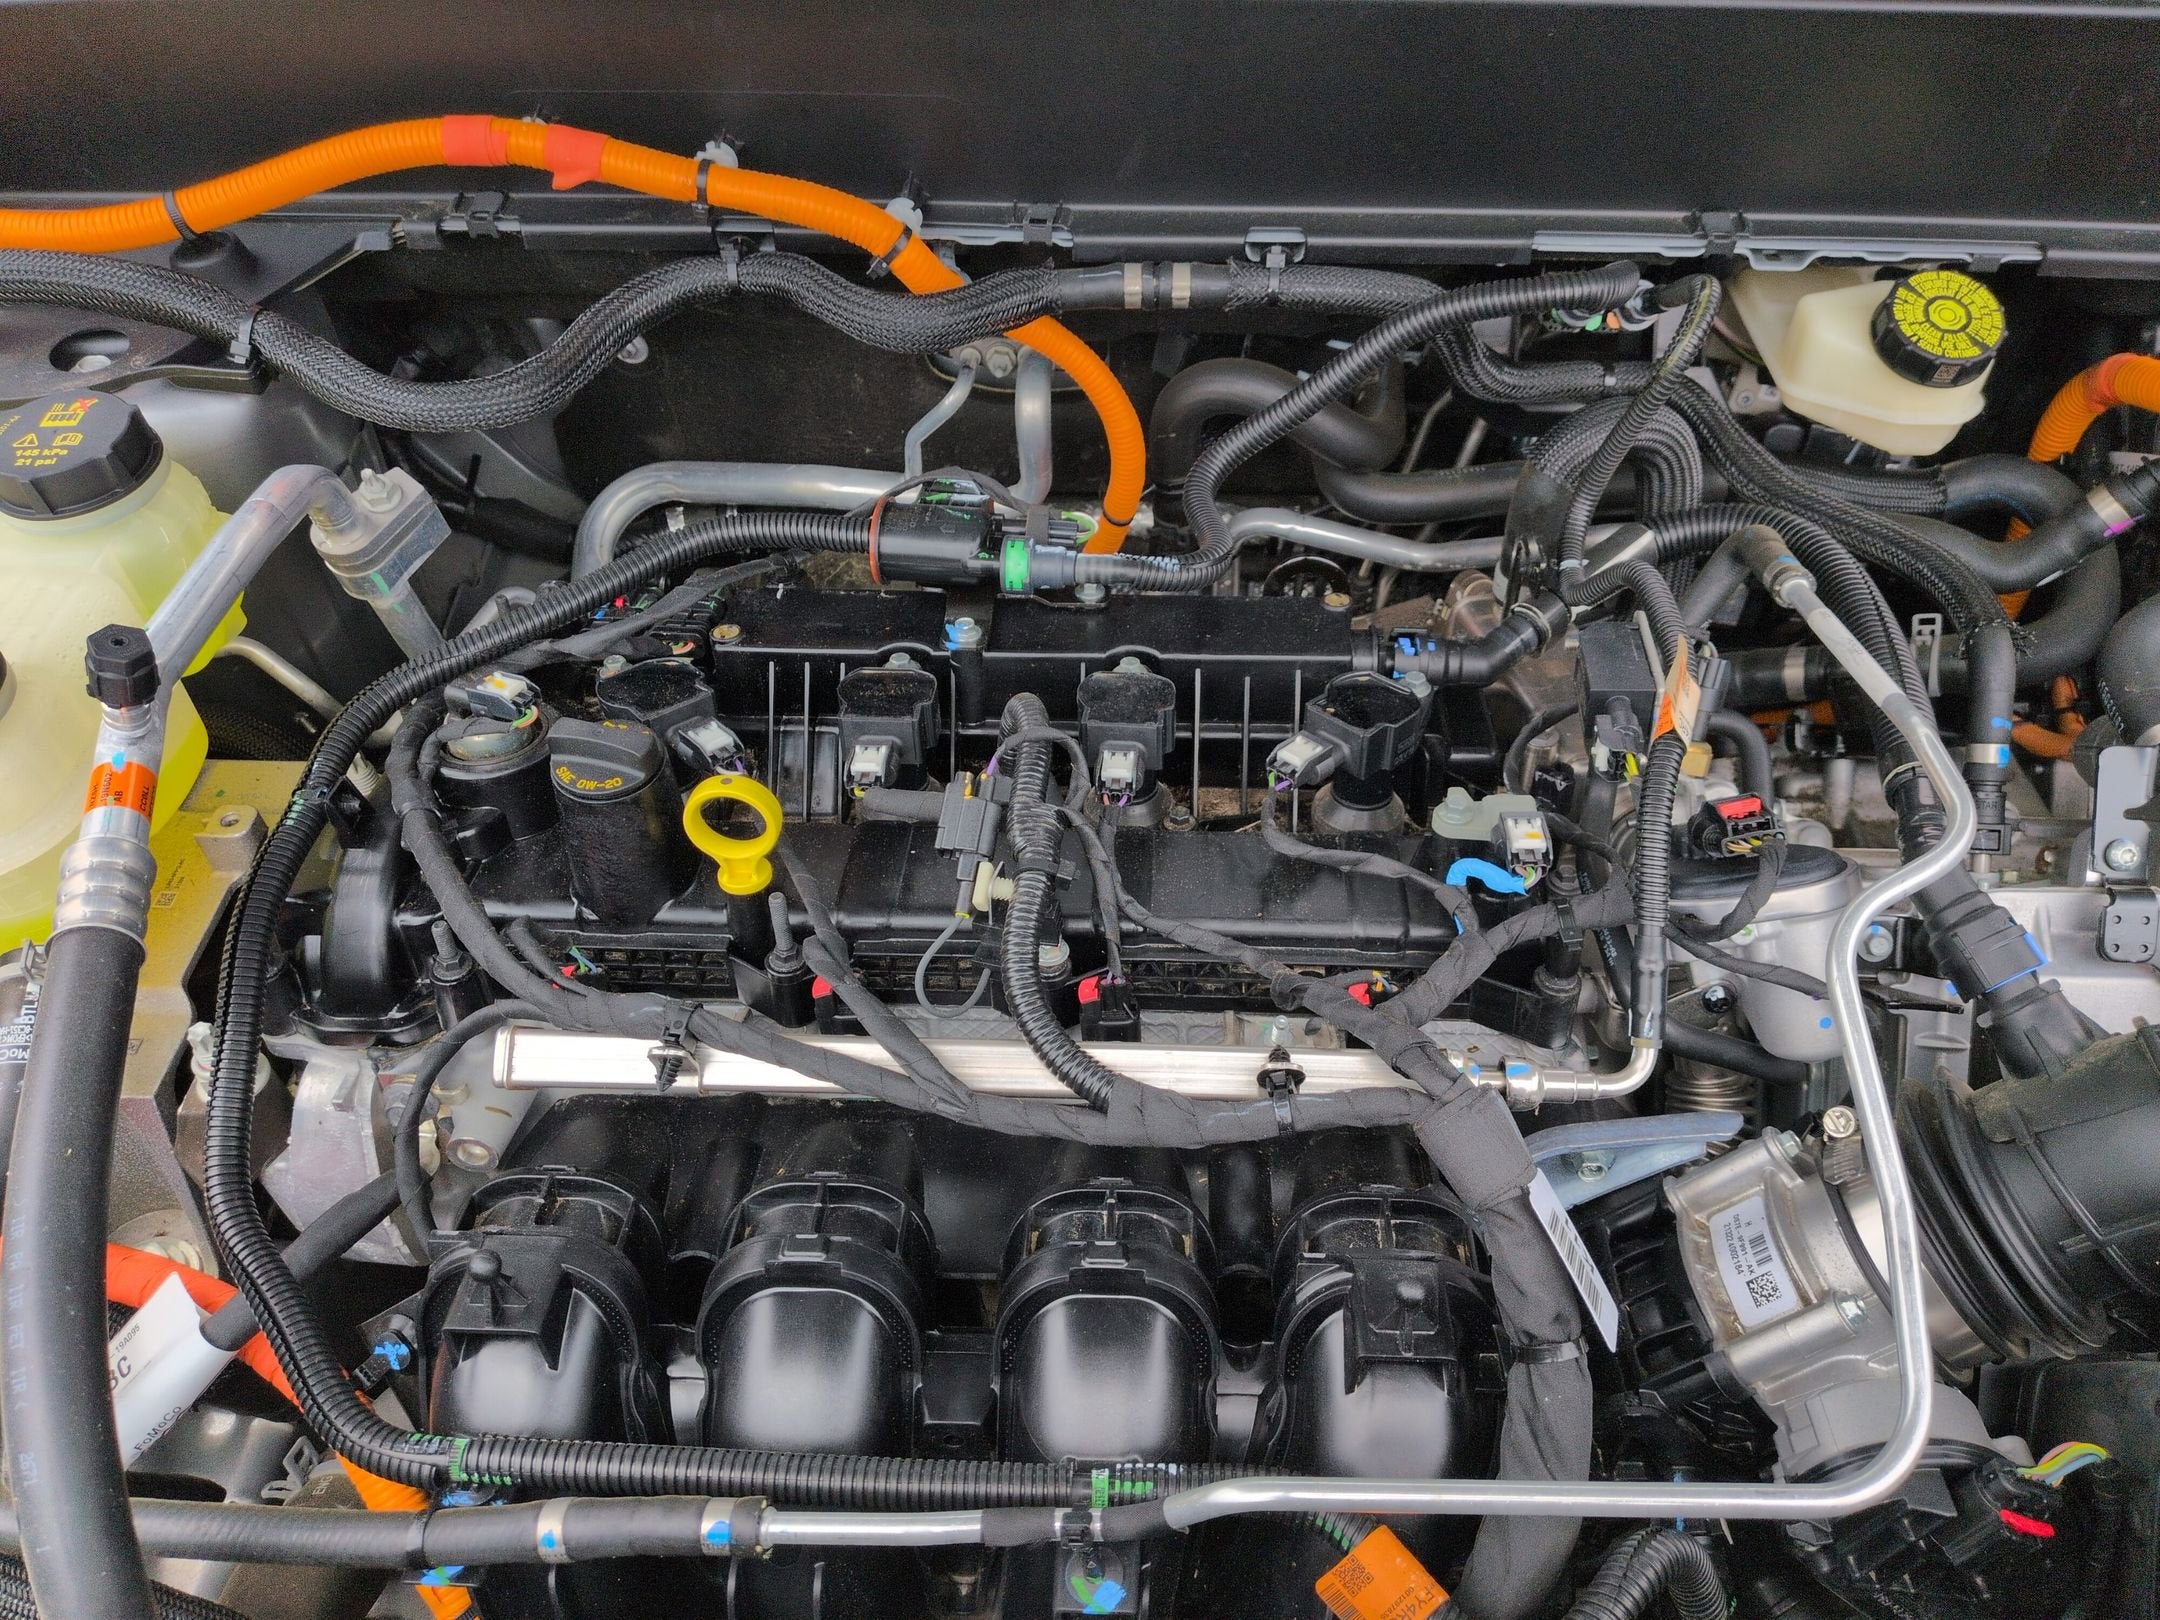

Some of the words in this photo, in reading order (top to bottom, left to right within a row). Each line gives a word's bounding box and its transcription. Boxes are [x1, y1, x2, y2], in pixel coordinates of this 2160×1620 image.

[15, 448, 39, 457] 145
[42, 448, 69, 456] kPa
[34, 458, 57, 467] psi
[555, 766, 577, 784] SAE
[134, 1405, 182, 1452] FoMoCo
